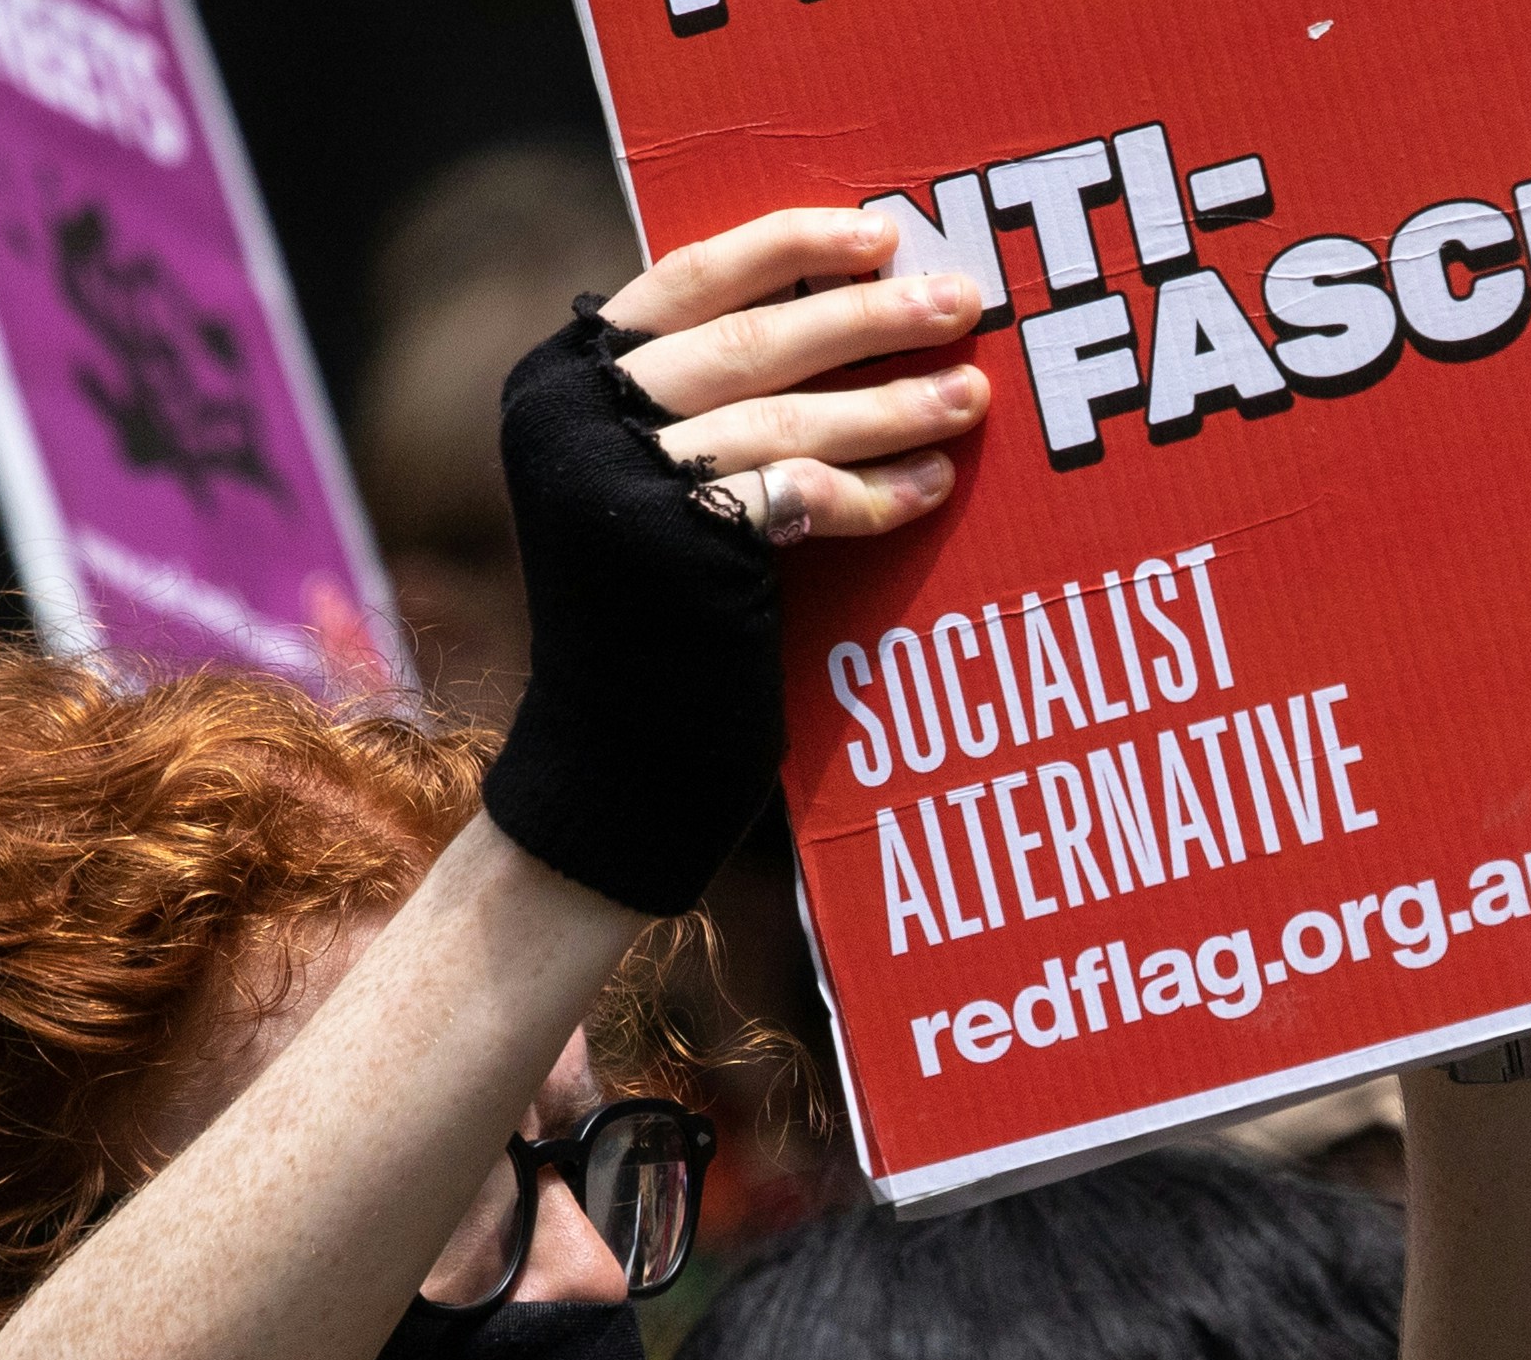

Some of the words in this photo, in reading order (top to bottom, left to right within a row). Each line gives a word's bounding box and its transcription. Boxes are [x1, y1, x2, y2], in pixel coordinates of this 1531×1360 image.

[794, 121, 1269, 359] NTI-
[827, 543, 1235, 787] SOCIALIST
[875, 684, 1378, 956] ALTERNATIVE
